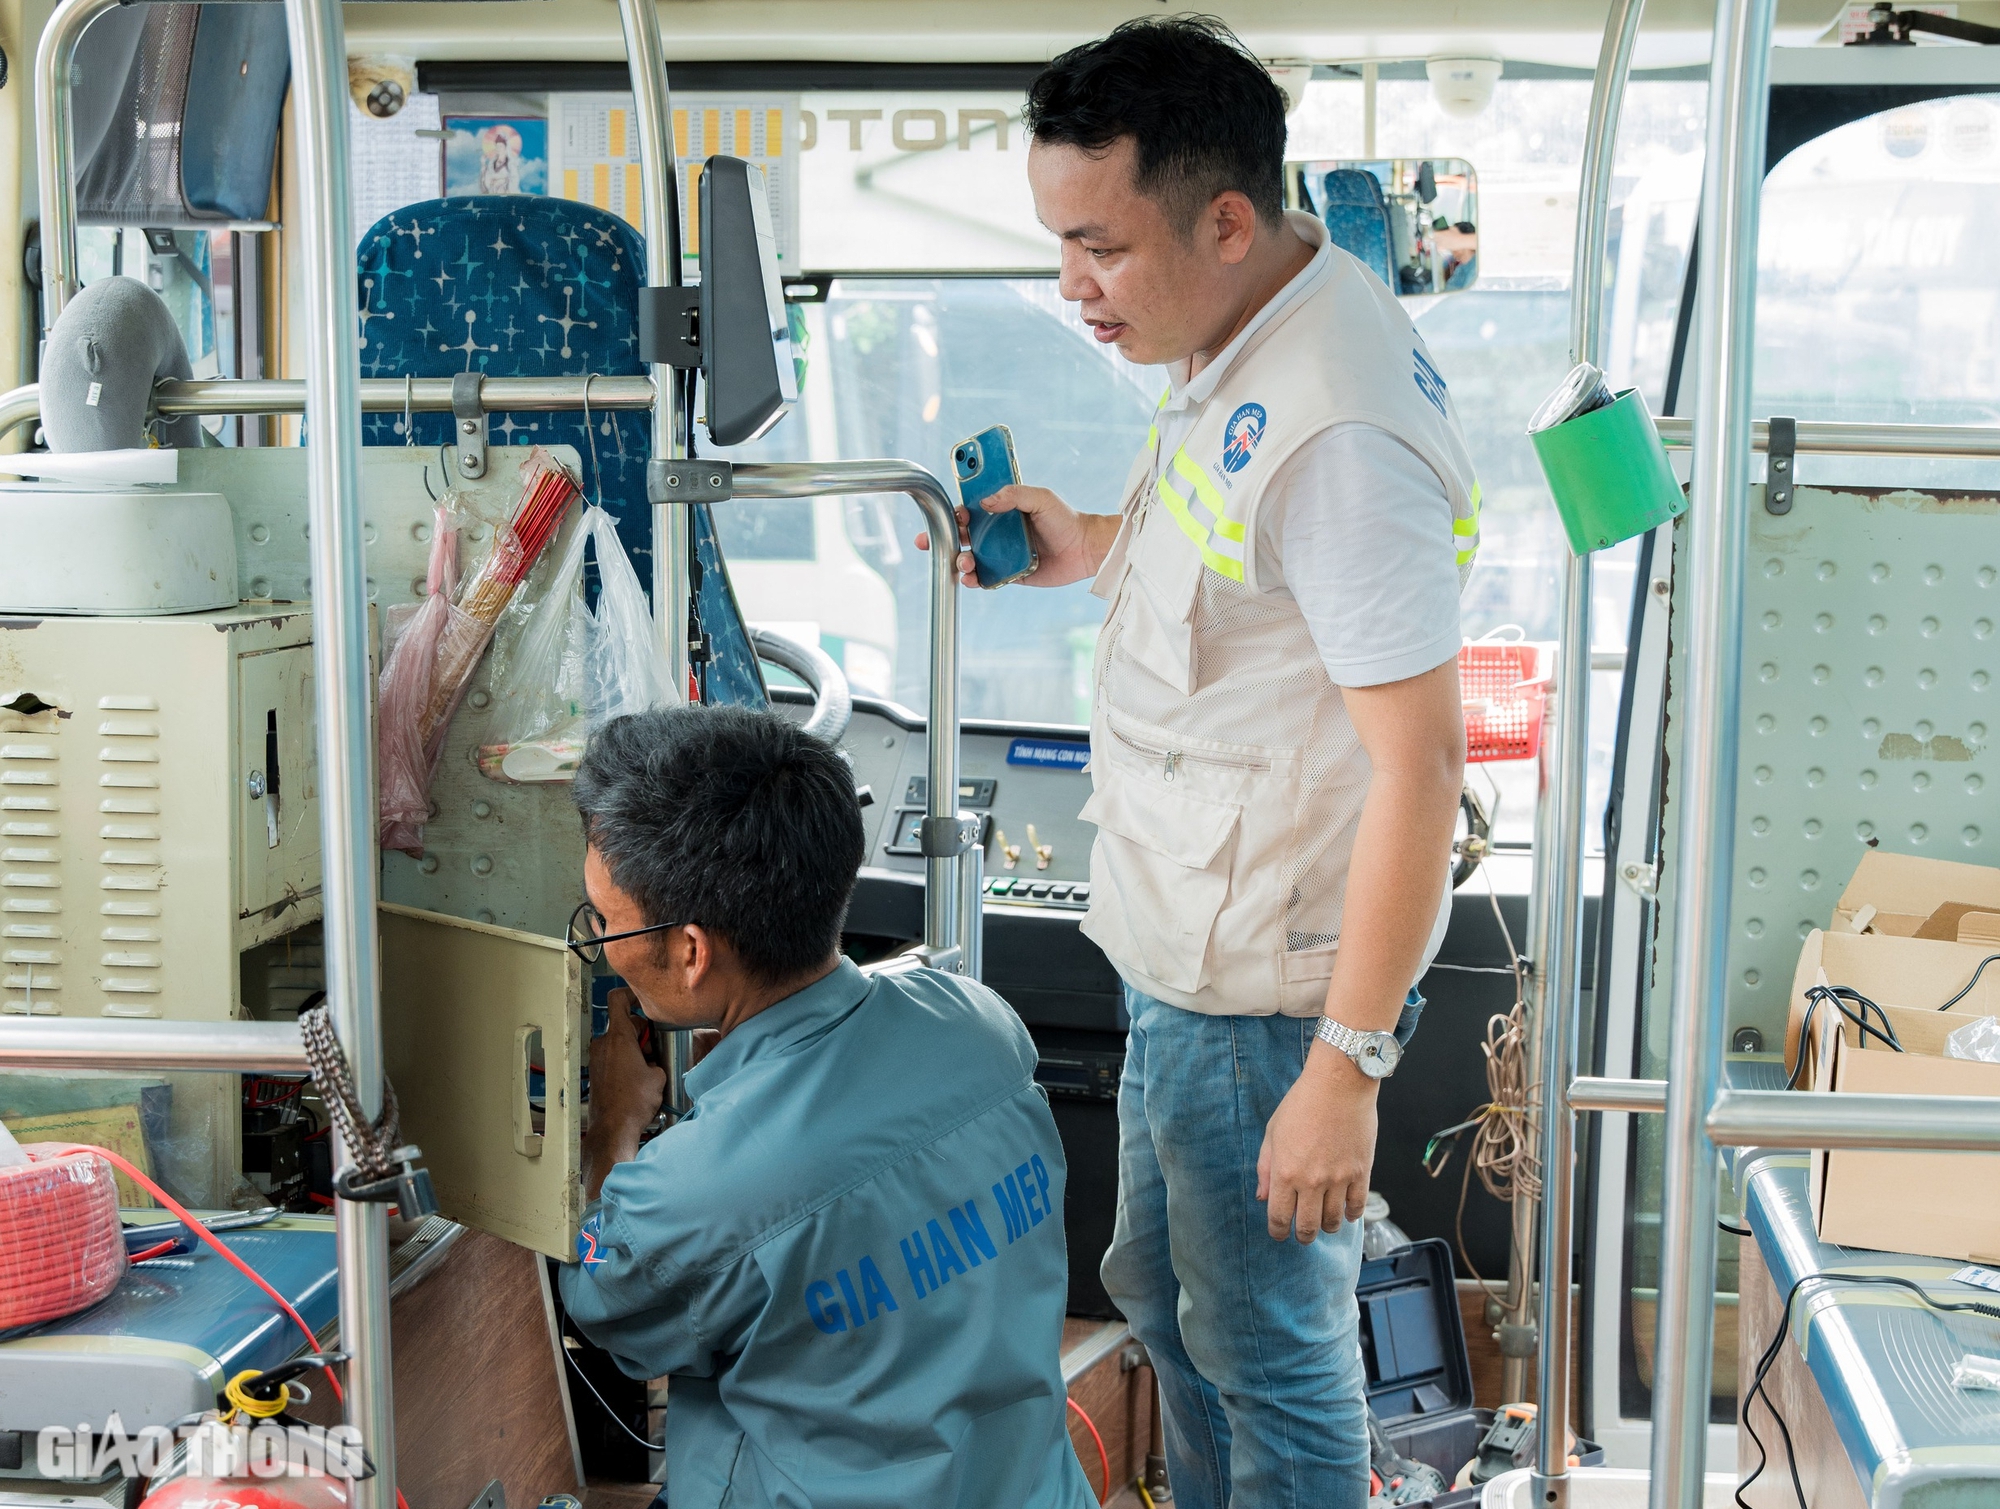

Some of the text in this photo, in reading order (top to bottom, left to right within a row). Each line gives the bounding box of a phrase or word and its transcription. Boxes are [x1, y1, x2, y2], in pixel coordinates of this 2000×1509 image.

[1057, 749, 1076, 762] CON
[804, 1153, 1052, 1335] GIA HAN MEP
